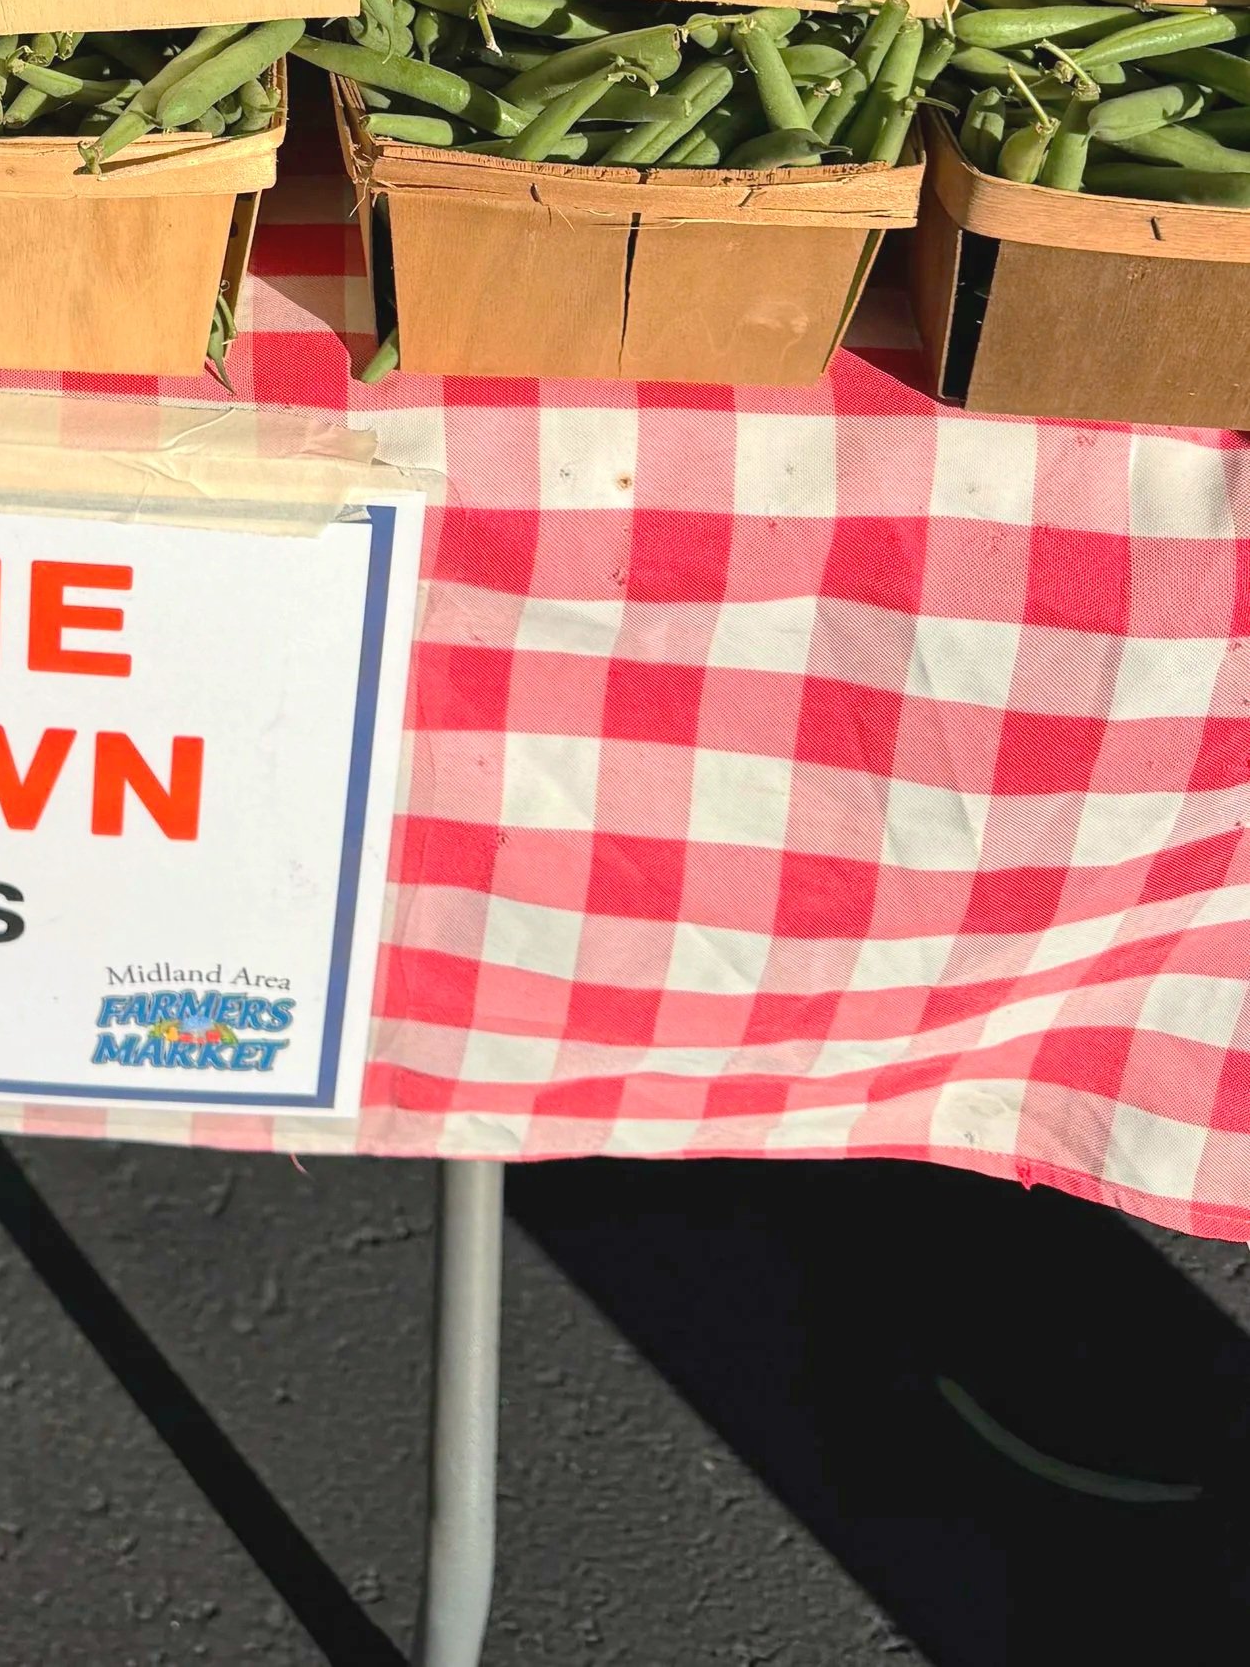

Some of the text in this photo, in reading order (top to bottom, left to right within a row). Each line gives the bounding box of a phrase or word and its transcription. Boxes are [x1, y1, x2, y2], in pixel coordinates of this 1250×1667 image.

[106, 962, 292, 991] Midland Area
[96, 988, 297, 1032] FARMERS
[91, 1031, 291, 1072] MARKET
